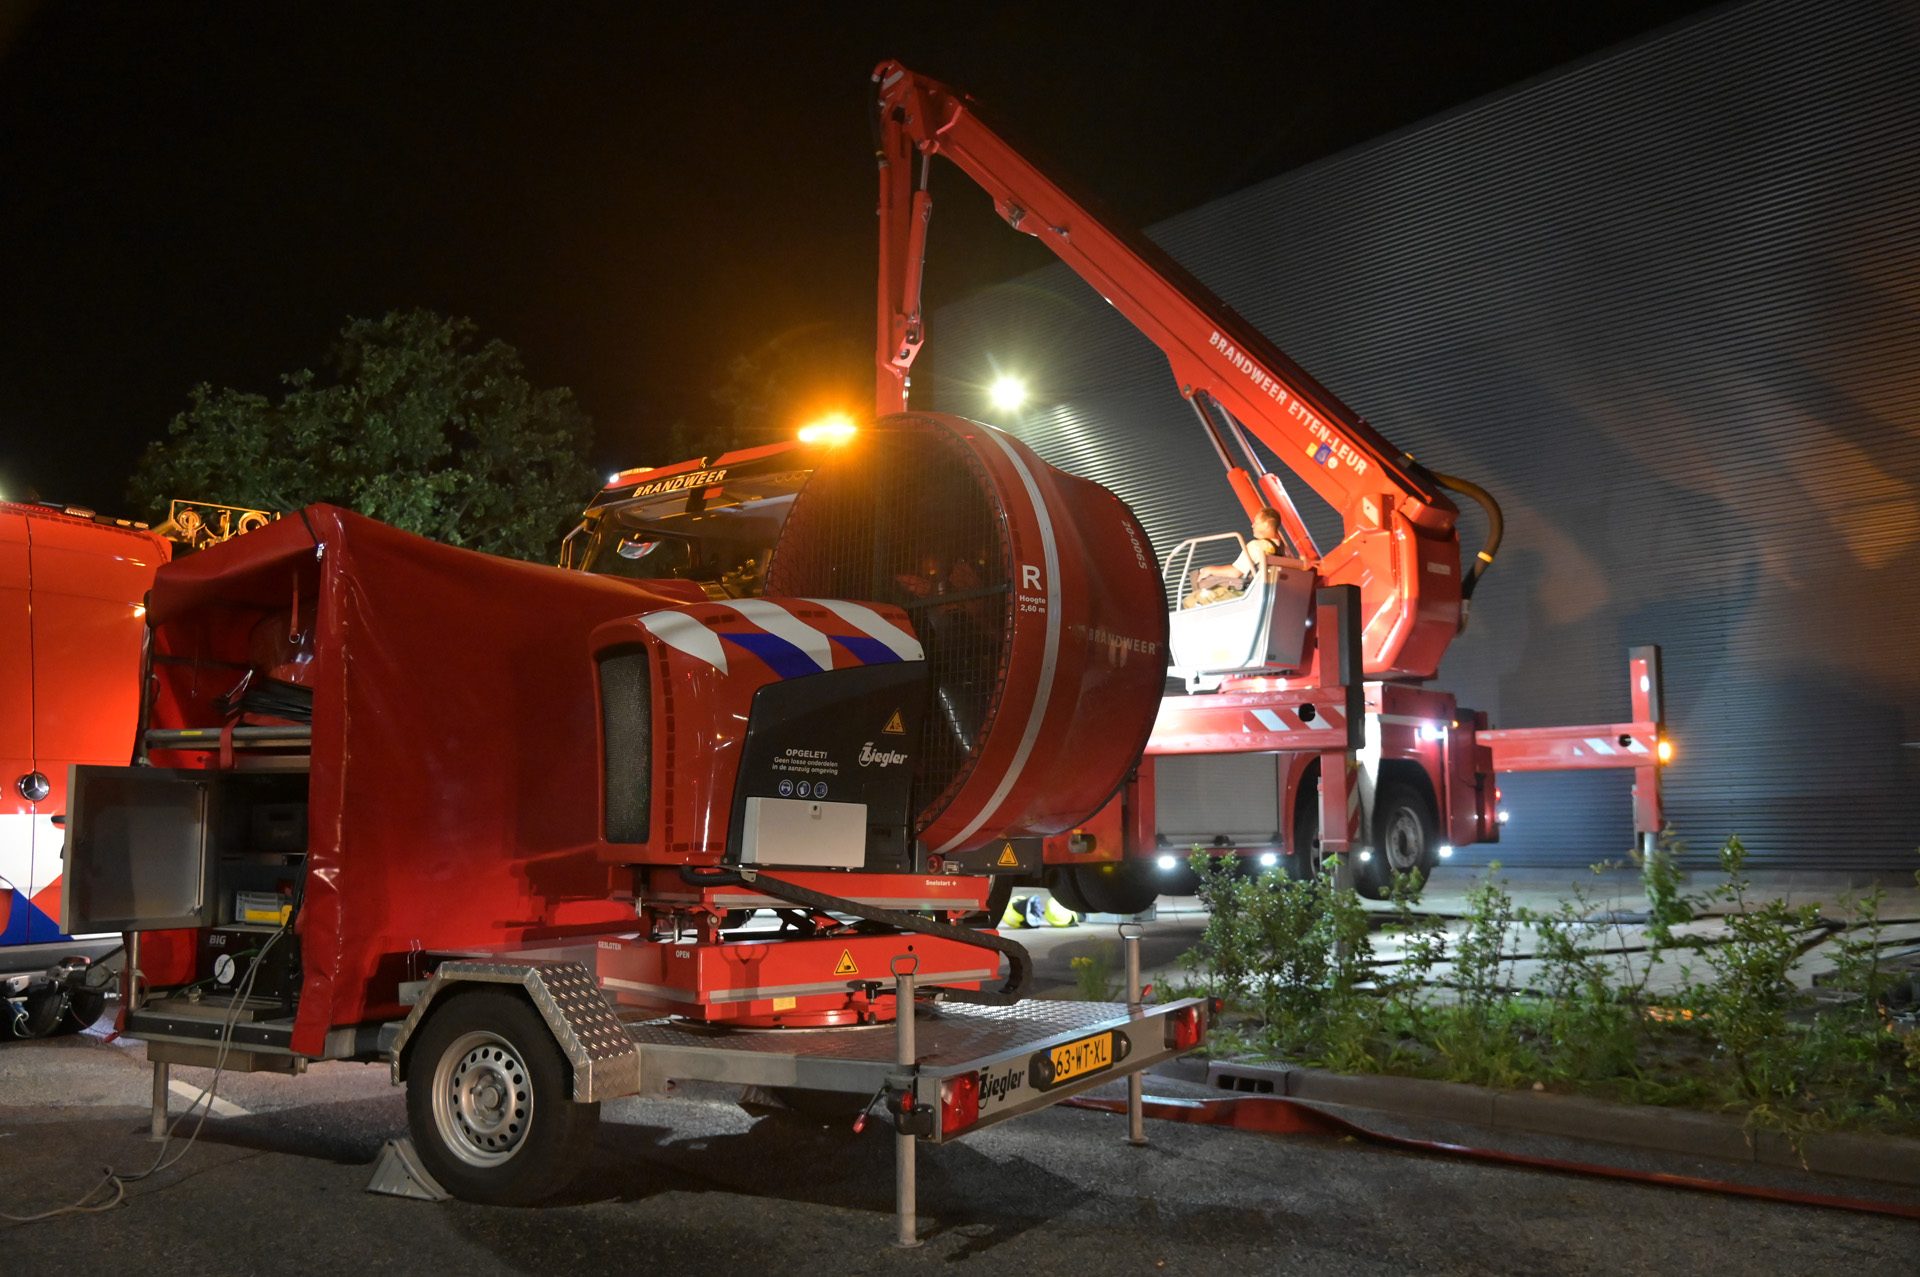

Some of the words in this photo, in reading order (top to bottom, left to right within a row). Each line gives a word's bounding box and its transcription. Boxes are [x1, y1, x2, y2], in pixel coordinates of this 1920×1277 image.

[1208, 331, 1288, 406] BRANDWEER
[1287, 400, 1368, 477] ETTEN-LEUR
[632, 469, 727, 498] BRANDWEER
[1022, 564, 1042, 591] R
[1019, 595, 1046, 604] Hoogte
[1088, 627, 1156, 656] BRANDWEER
[774, 756, 790, 764] Geen
[785, 748, 828, 760] OPGELET!
[859, 741, 908, 768] Ziegler
[209, 935, 227, 945] BIG
[675, 949, 690, 959] OPEN
[1055, 1038, 1107, 1077] 63-WT-XL
[977, 1066, 1025, 1110] Ziegler
